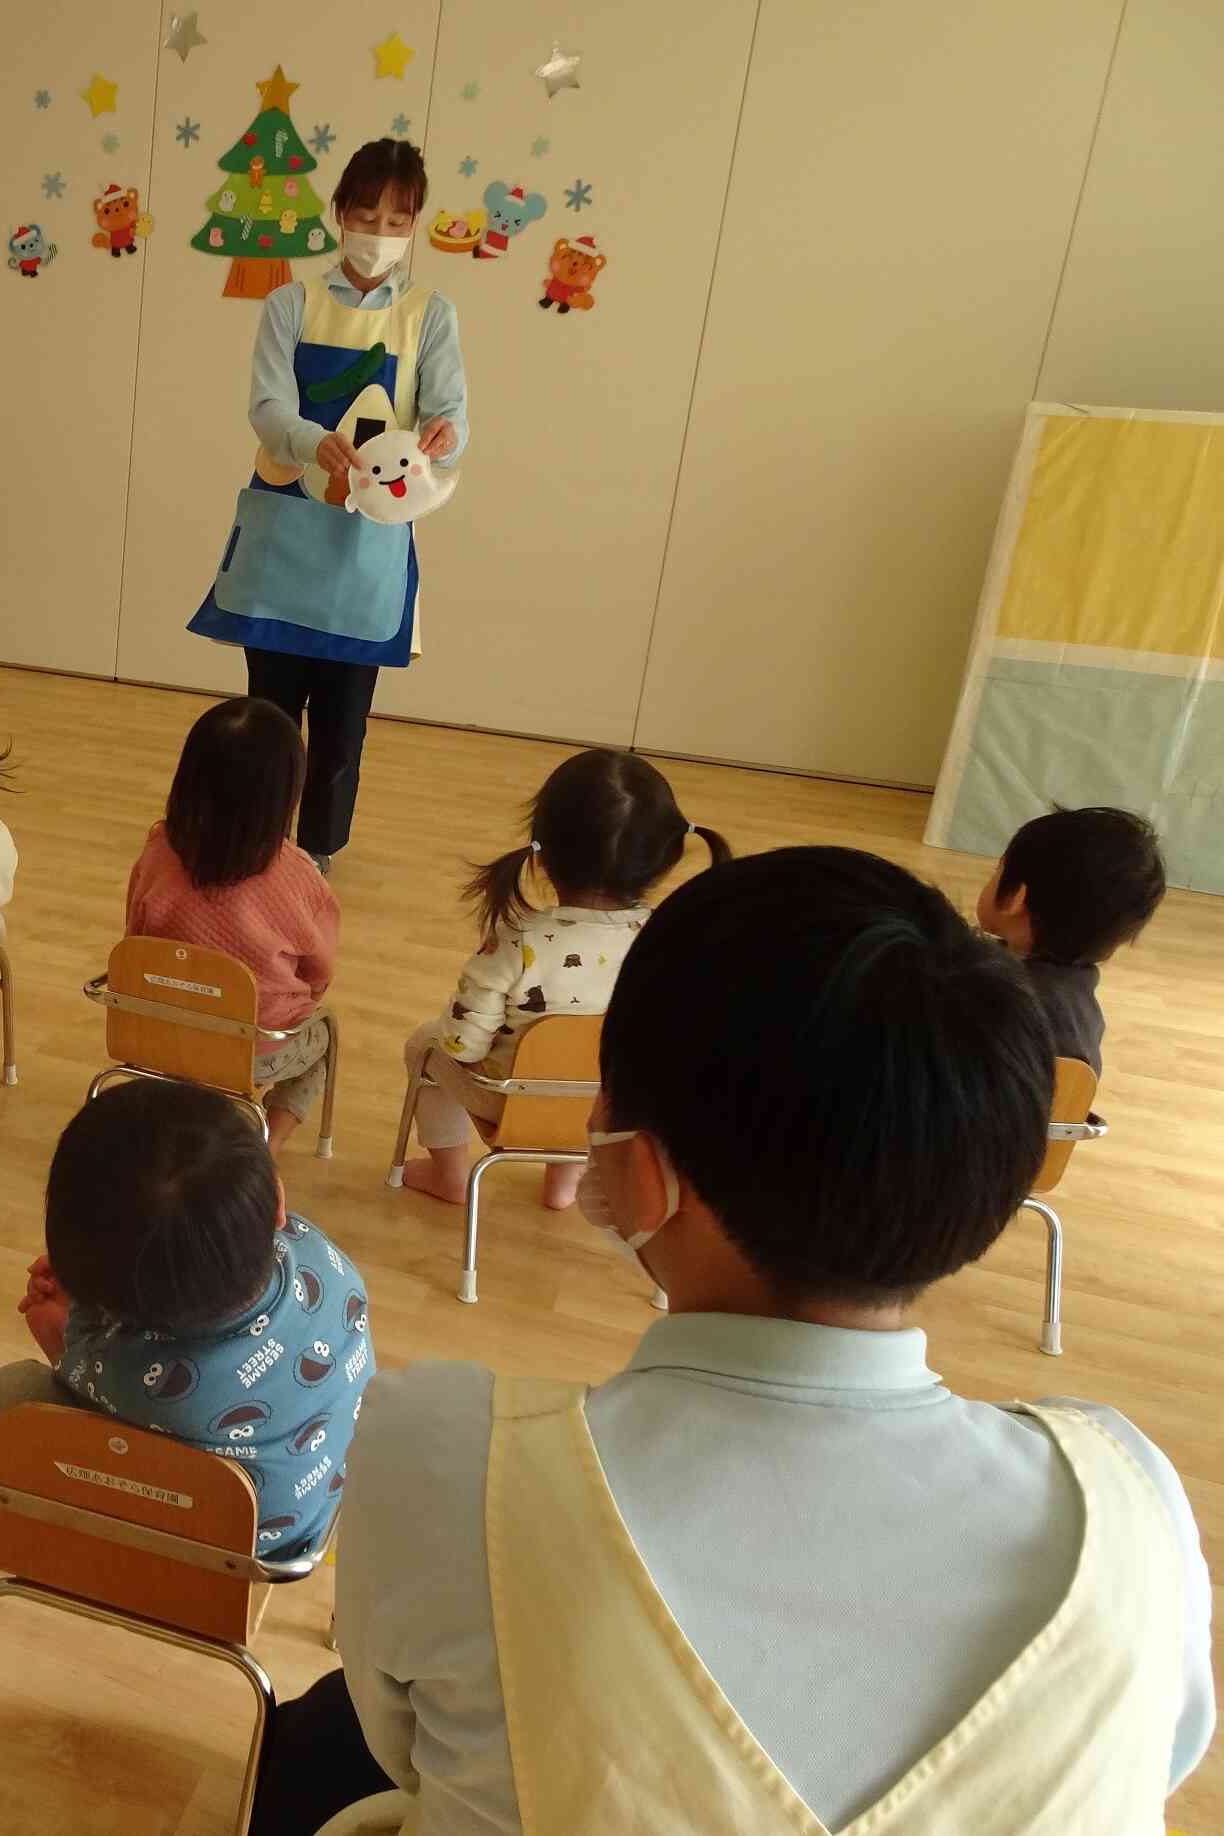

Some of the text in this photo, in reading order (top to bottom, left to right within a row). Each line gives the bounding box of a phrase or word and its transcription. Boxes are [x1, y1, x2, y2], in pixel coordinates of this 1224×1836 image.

[236, 1338, 276, 1380] STREET
[241, 1343, 284, 1389] SESAME
[206, 1446, 258, 1459] SAME
